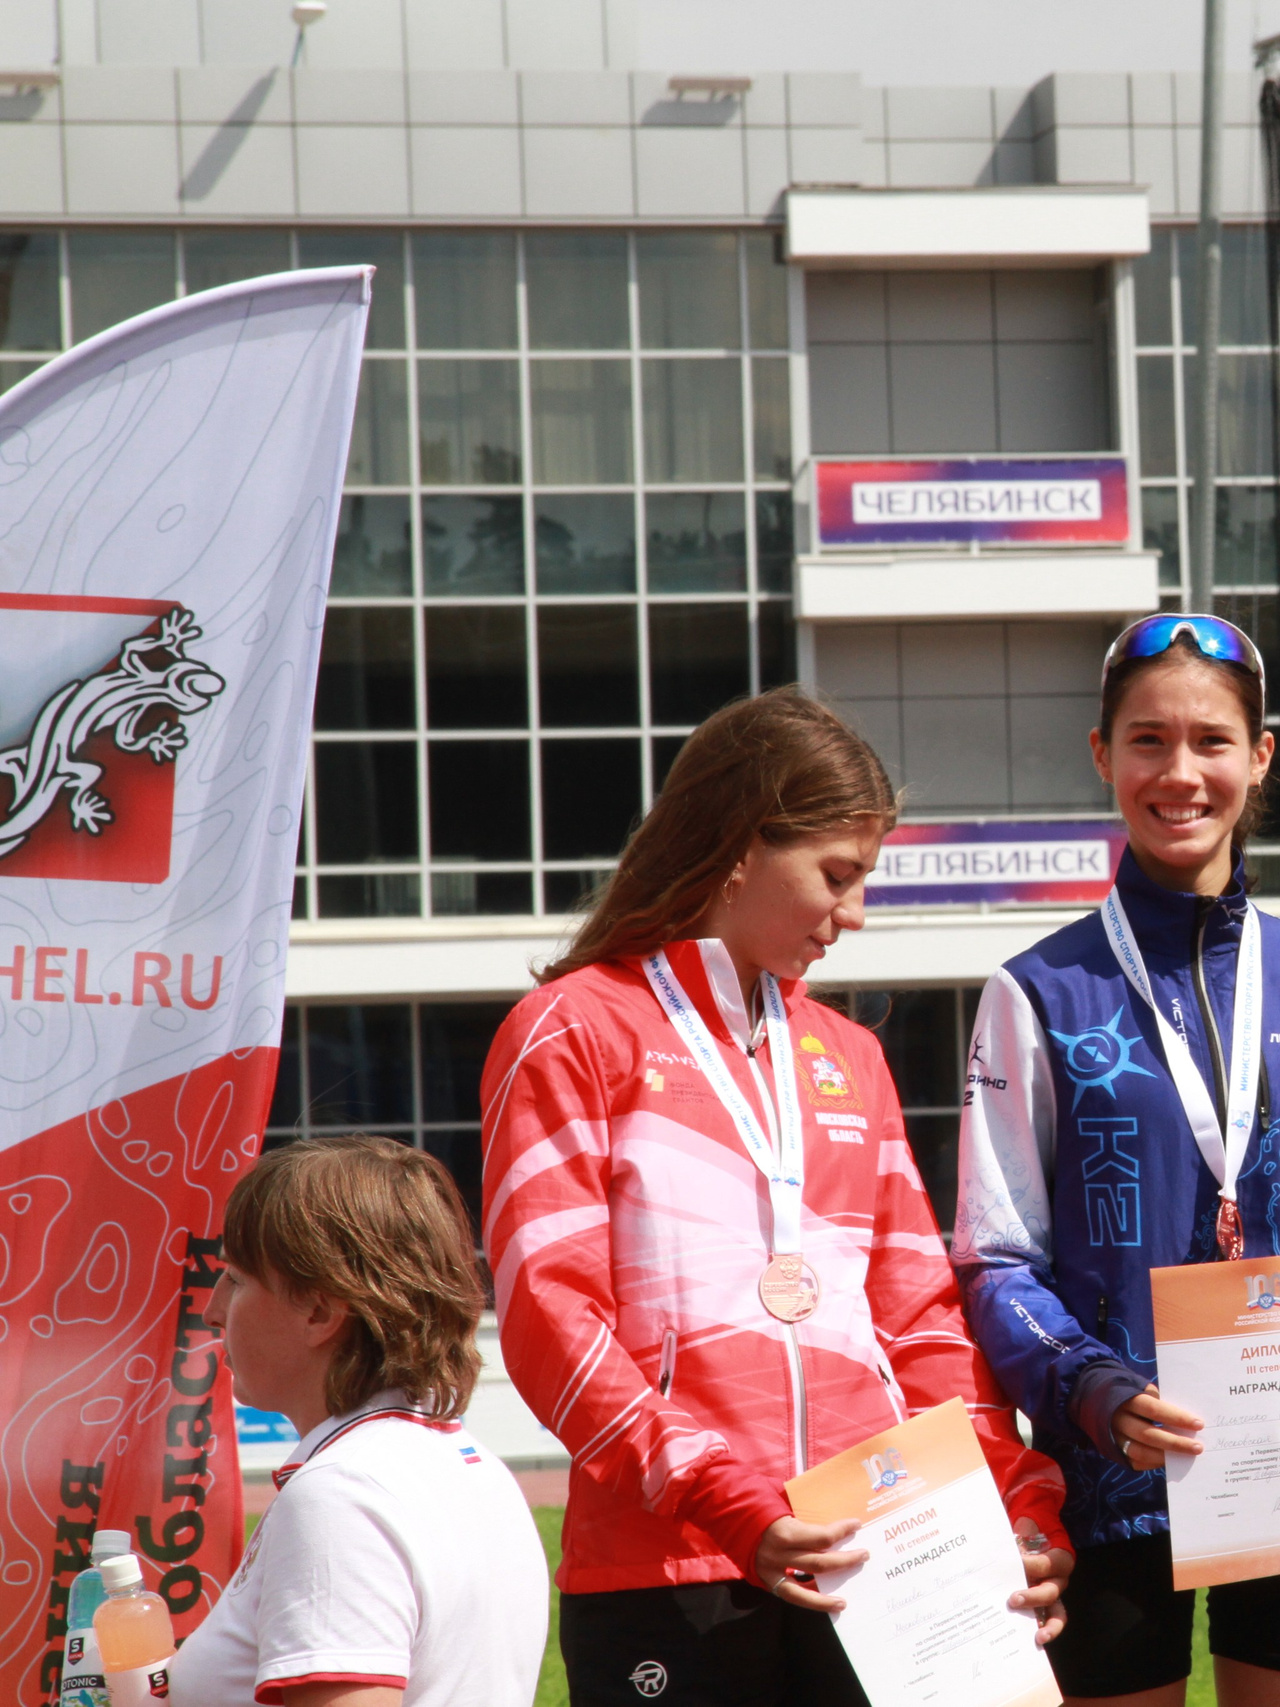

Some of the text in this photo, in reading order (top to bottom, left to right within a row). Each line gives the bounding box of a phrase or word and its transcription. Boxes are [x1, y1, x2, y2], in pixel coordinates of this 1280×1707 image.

[859, 486, 1092, 515] ЧЕЛЯБИНСК
[1119, 941, 1139, 977] СПОРТА
[652, 968, 698, 1035] РОССИЙСКОЙ
[769, 990, 781, 1023] СПОРТА
[1245, 981, 1253, 1016] СПОРТА
[1171, 997, 1189, 1050] VICTO
[692, 1033, 719, 1074] СПОРТА
[1240, 1016, 1252, 1092] МИНИСТЕРСТВО
[714, 1071, 763, 1151] МИНИСТЕРСТВО
[1245, 1365, 1256, 1374] III
[135, 1231, 225, 1615] области
[881, 1507, 939, 1543] ДИПЛОМ
[893, 1528, 940, 1554] III степени
[885, 1534, 968, 1580] НАГРАЖДАЕТСЯ
